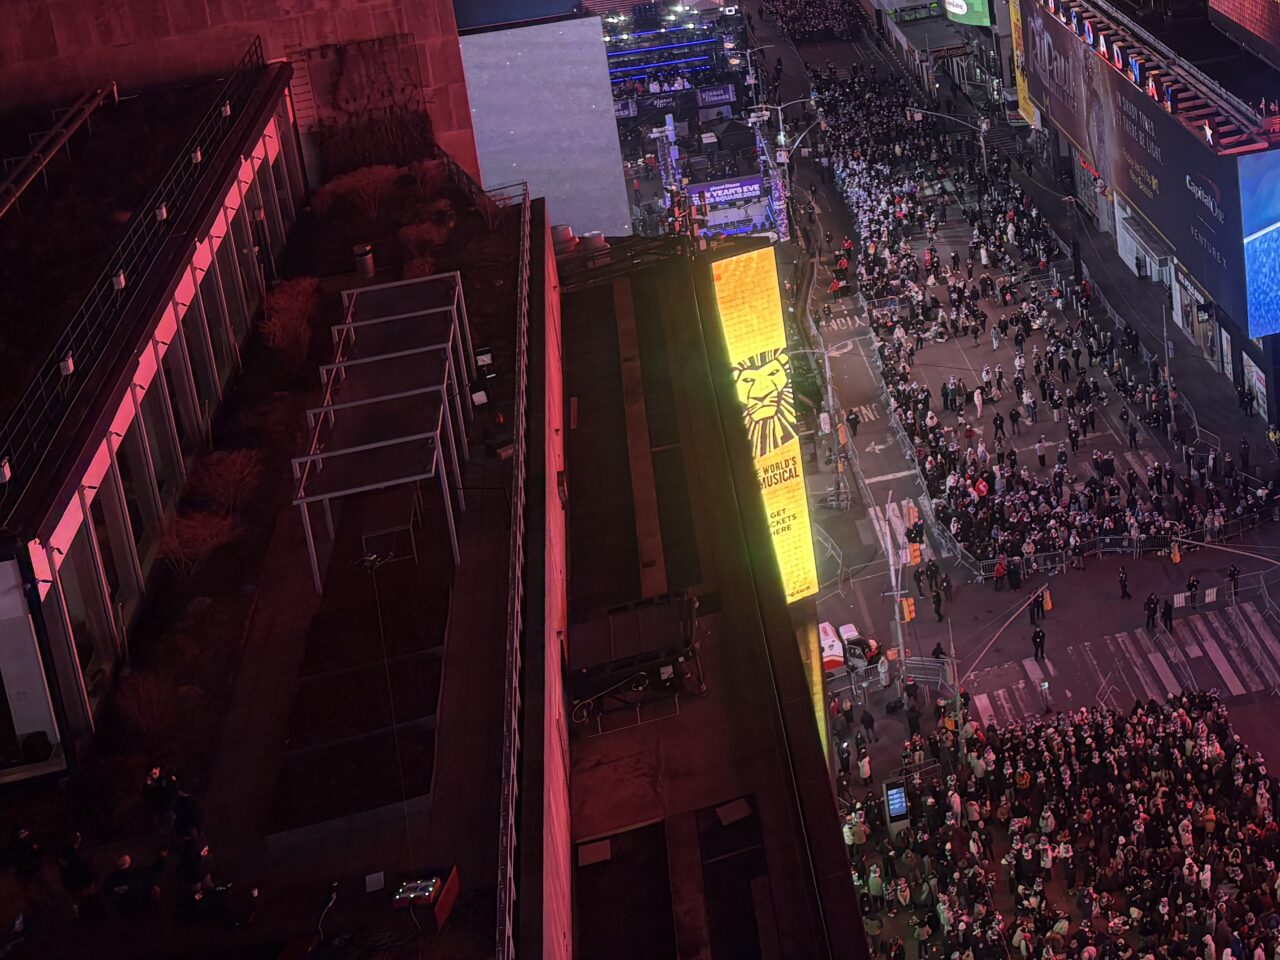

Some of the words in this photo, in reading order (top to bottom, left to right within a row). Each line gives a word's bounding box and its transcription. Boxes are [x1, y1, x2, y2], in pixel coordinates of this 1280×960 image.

[713, 187, 742, 197] YEAR'S
[743, 184, 760, 192] EVE
[763, 456, 797, 476] WORLD'S
[760, 467, 800, 489] MUSICAL
[770, 508, 787, 519] GET
